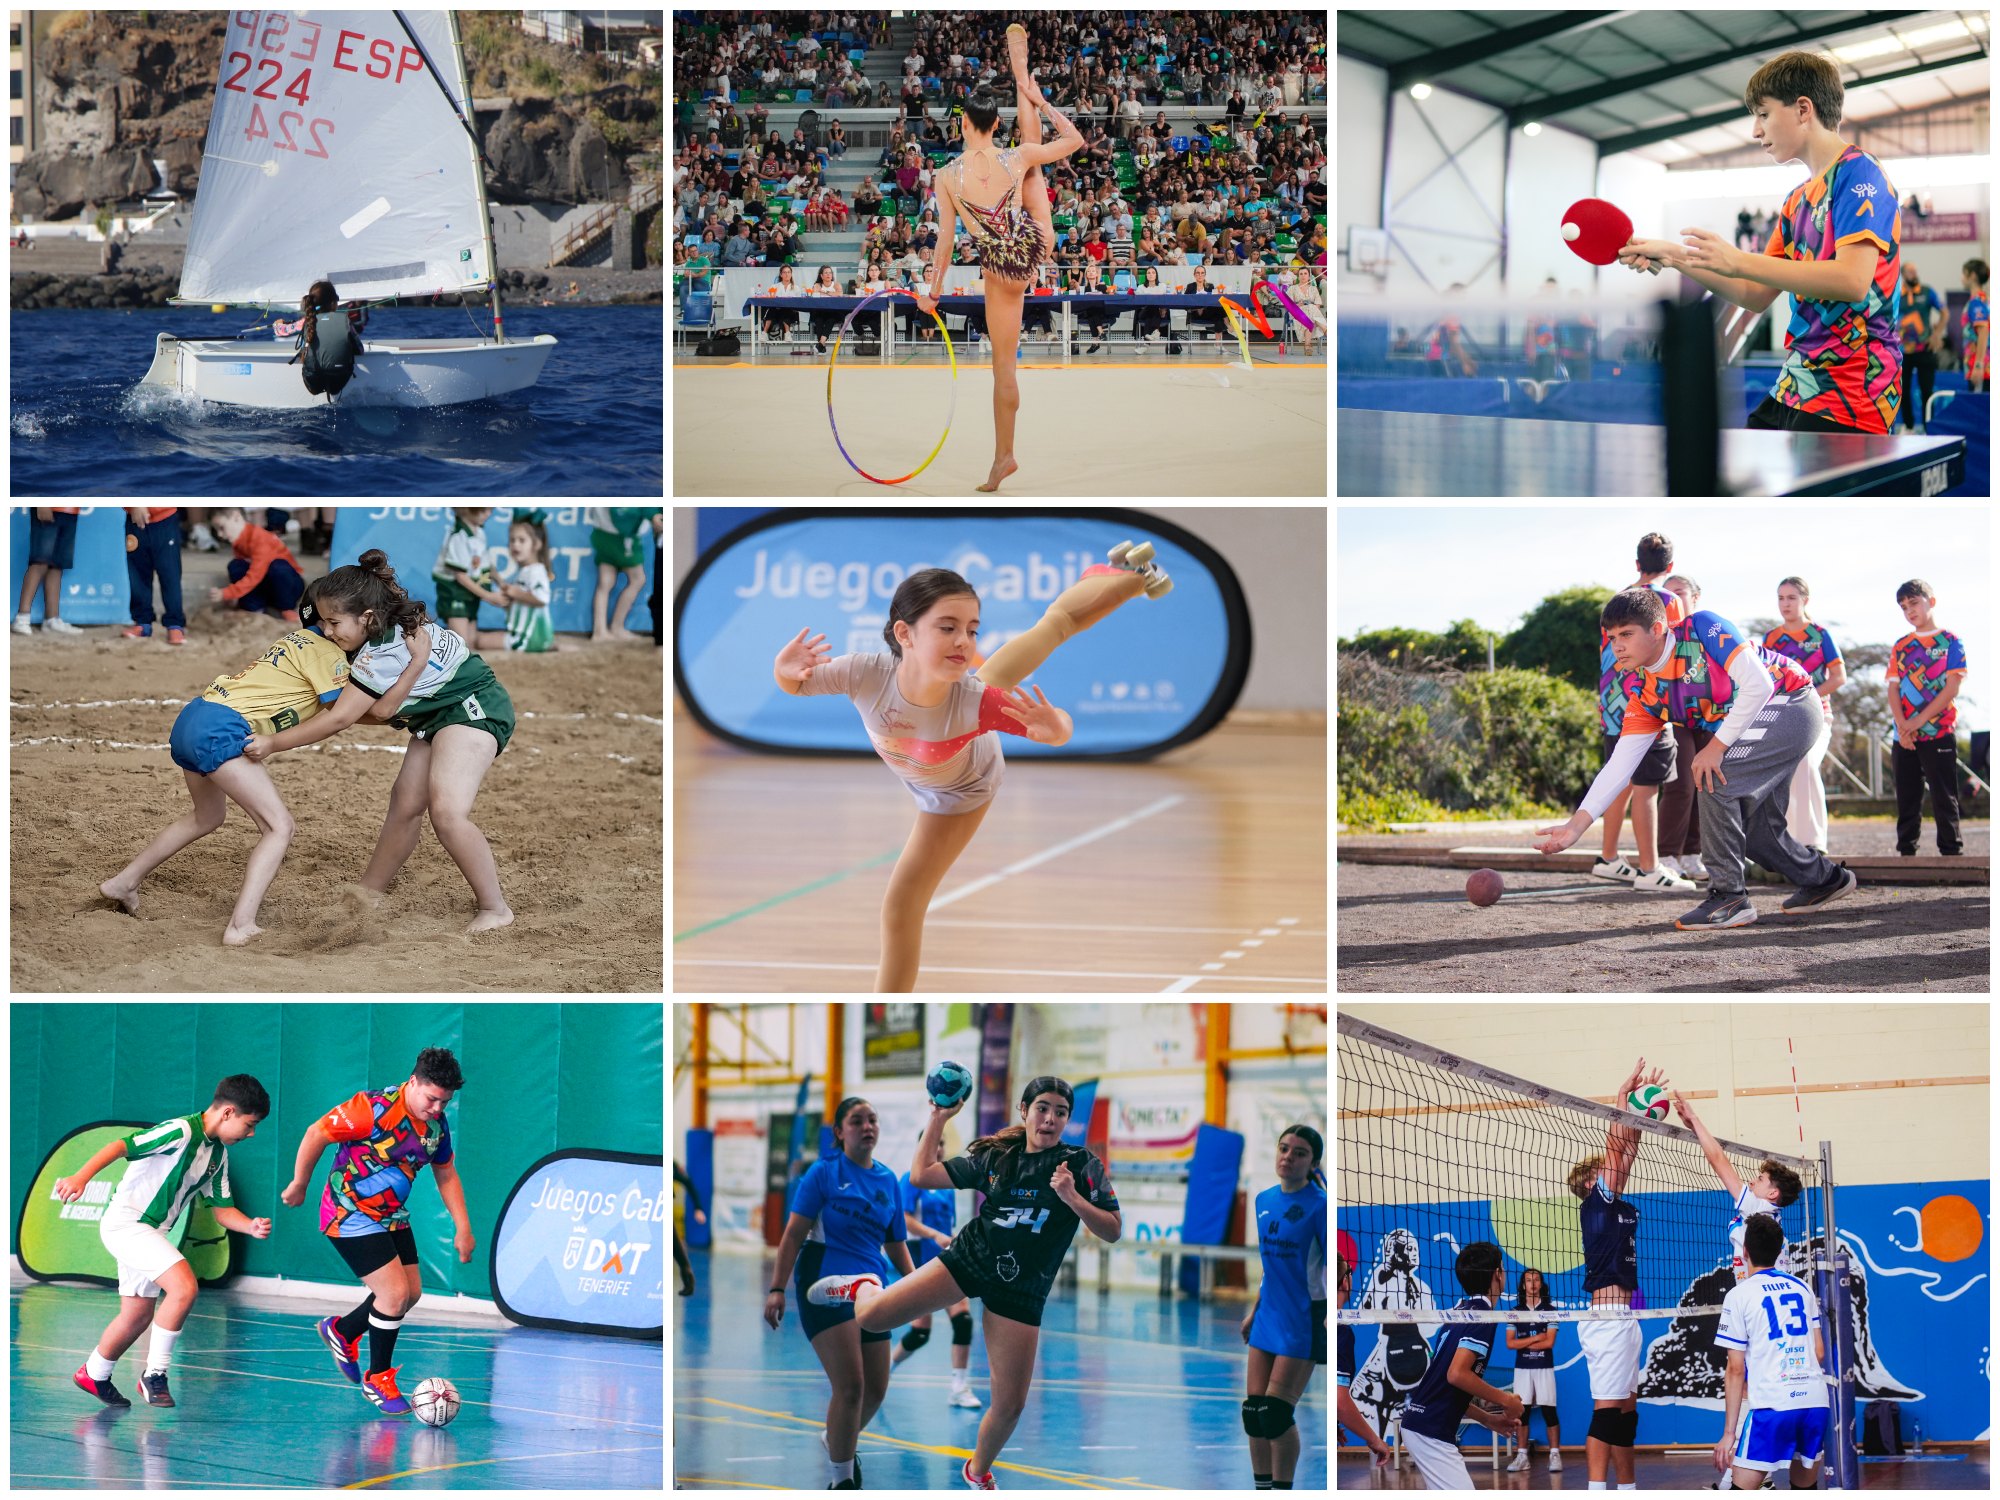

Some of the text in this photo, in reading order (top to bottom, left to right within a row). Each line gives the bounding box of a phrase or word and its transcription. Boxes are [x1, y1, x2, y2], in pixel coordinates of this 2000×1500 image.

[333, 29, 424, 84] ESP
[223, 51, 312, 107] 224
[530, 1177, 617, 1222] Juegos
[1017, 1189, 1039, 1197] DXT
[992, 1206, 1050, 1234] 34
[583, 1238, 651, 1275] DXT
[577, 1277, 632, 1296] TENERIFE
[1761, 1282, 1792, 1293] FILIPE
[1761, 1292, 1809, 1341] 13
